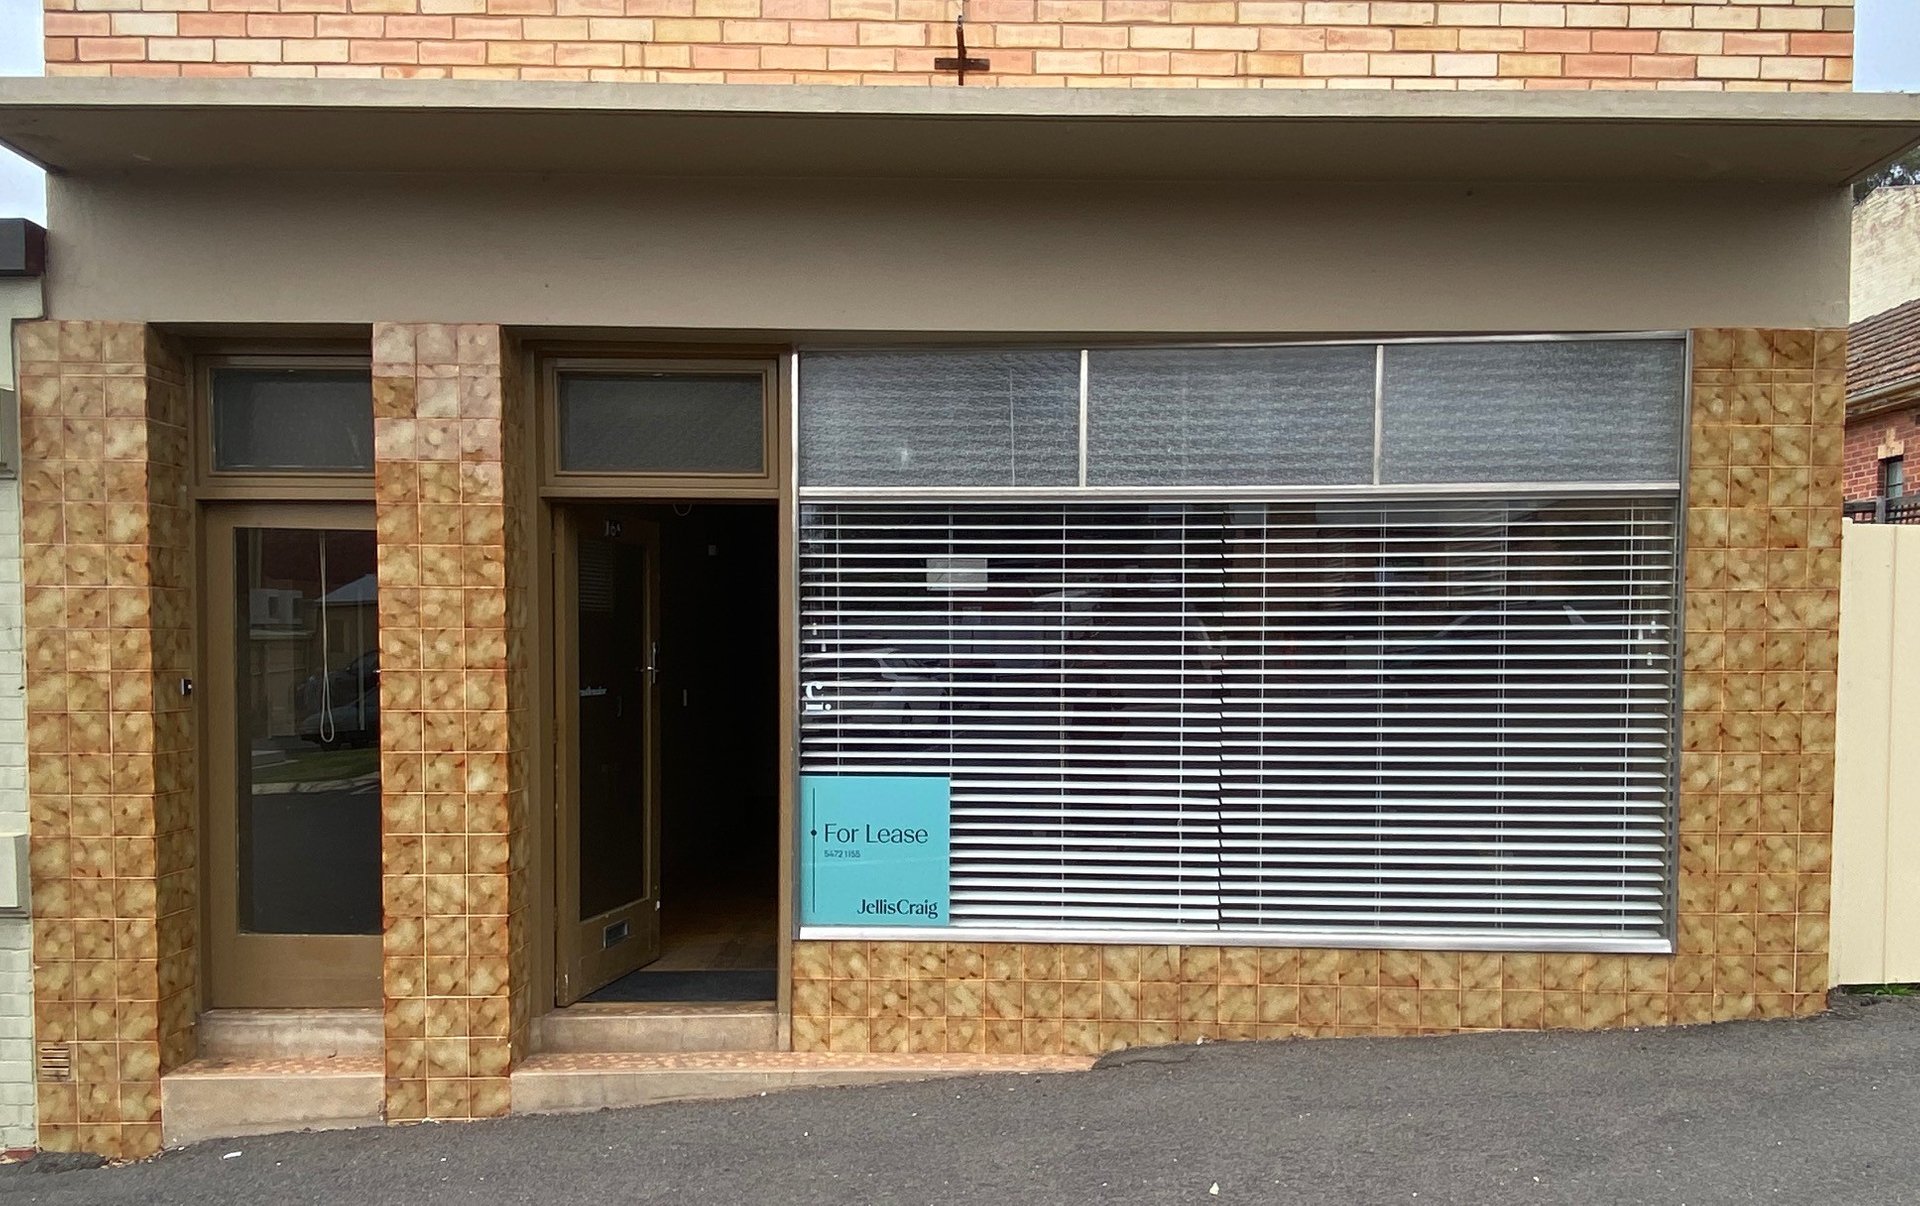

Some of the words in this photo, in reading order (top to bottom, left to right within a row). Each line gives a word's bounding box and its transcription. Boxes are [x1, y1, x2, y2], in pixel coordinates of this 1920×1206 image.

[824, 823, 860, 843] For
[865, 823, 929, 844] Lease
[857, 899, 939, 920] JellisCraig
